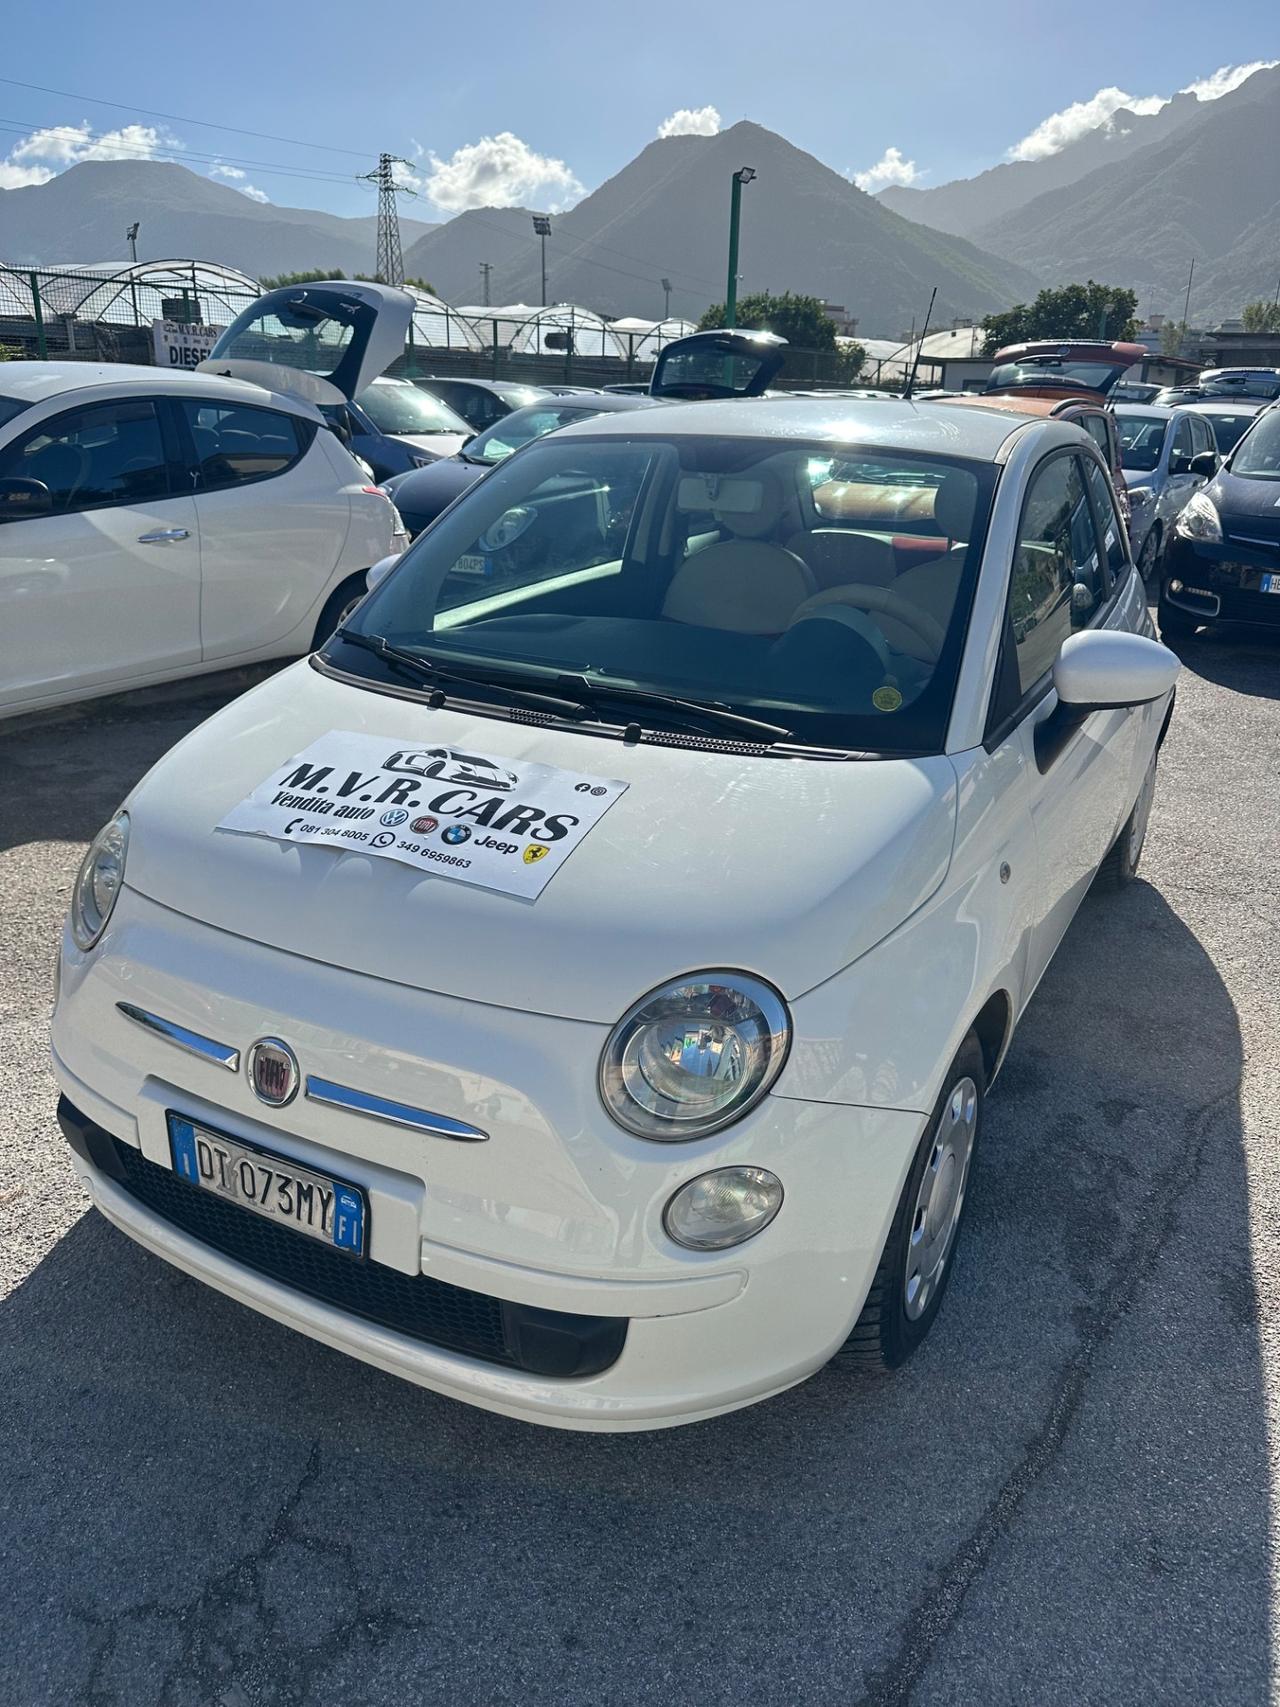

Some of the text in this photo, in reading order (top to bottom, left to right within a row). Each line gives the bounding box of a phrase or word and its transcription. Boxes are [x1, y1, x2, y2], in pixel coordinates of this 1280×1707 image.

[271, 791, 376, 820] Vendita auto
[300, 824, 370, 841] 081 304 8005
[397, 840, 473, 870] 349 6959863
[474, 835, 519, 855] Jeep
